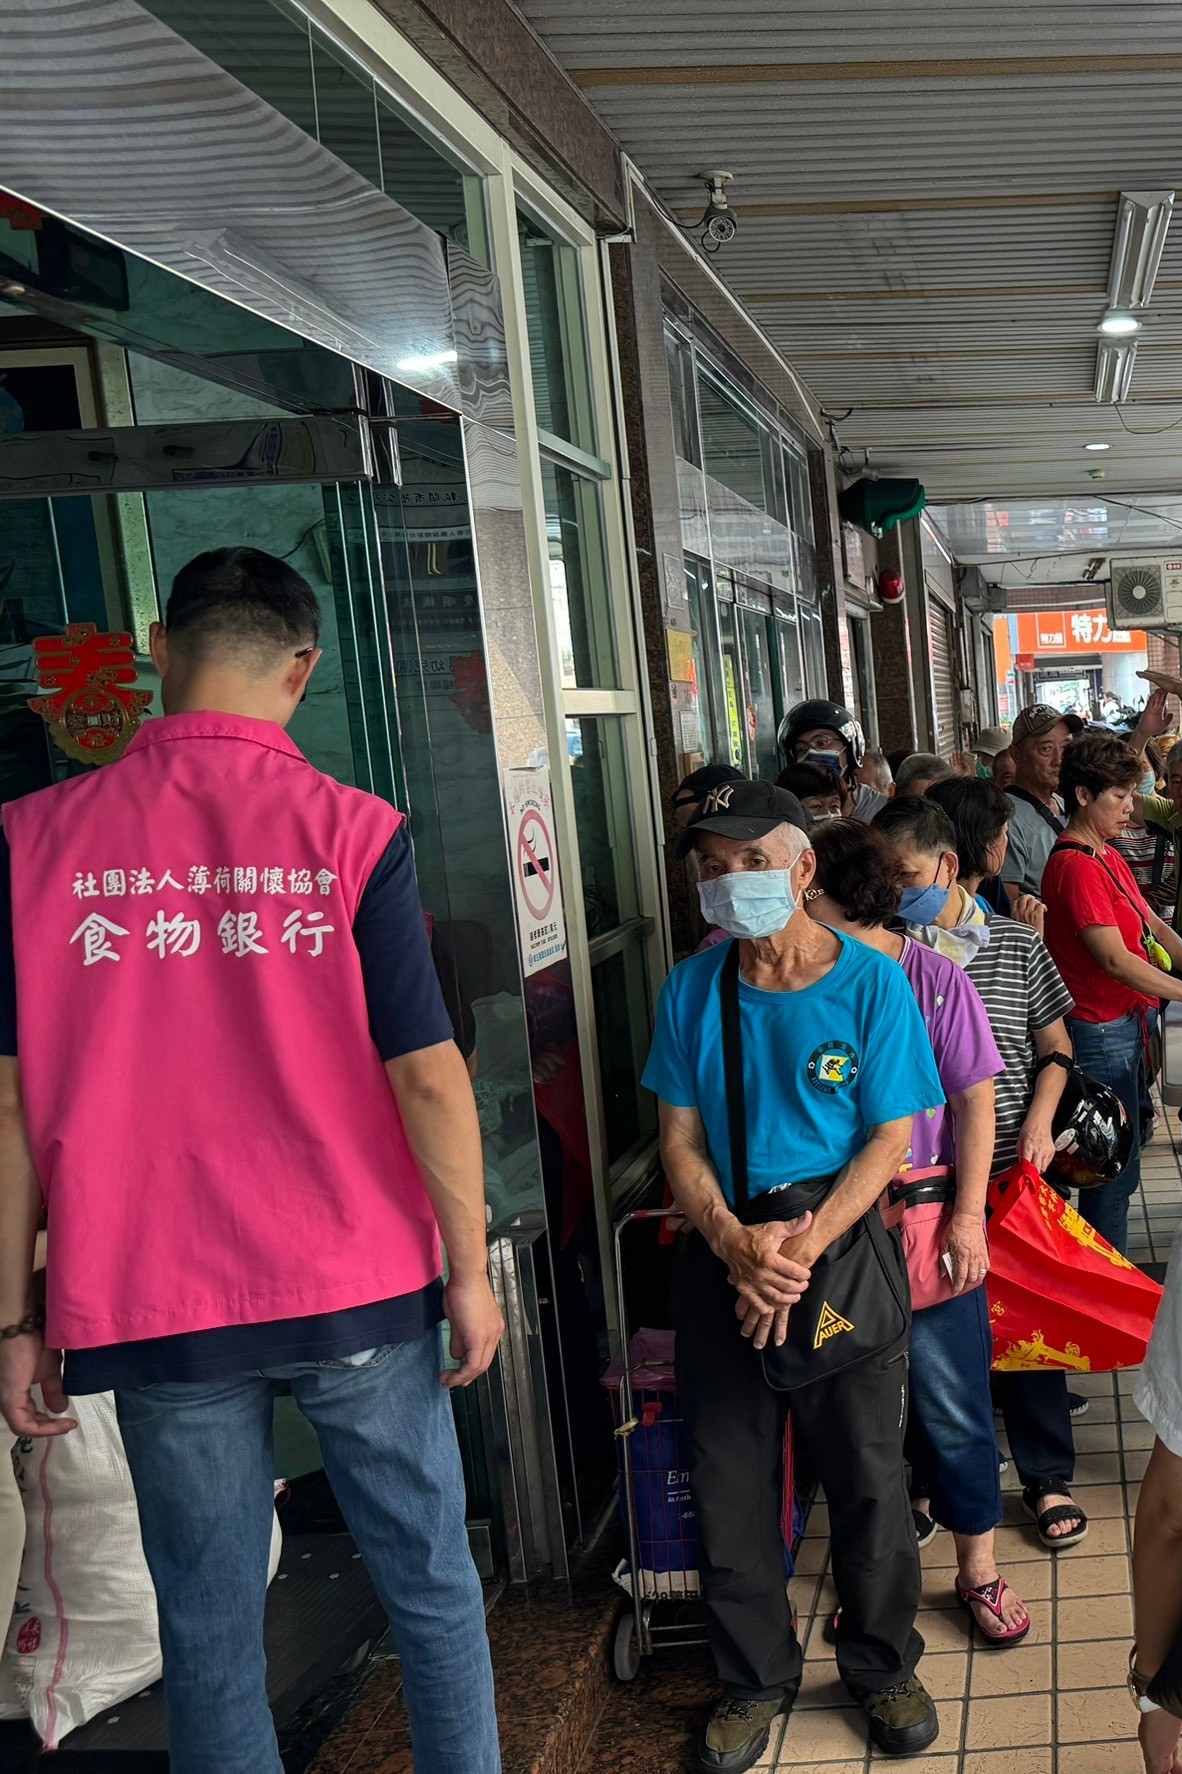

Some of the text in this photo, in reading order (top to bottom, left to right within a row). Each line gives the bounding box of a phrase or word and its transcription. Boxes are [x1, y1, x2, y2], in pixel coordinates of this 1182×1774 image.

[702, 784, 735, 814] NY
[72, 865, 337, 899] 社團法人薄荷關懷協會
[69, 909, 335, 966] 食物銀行
